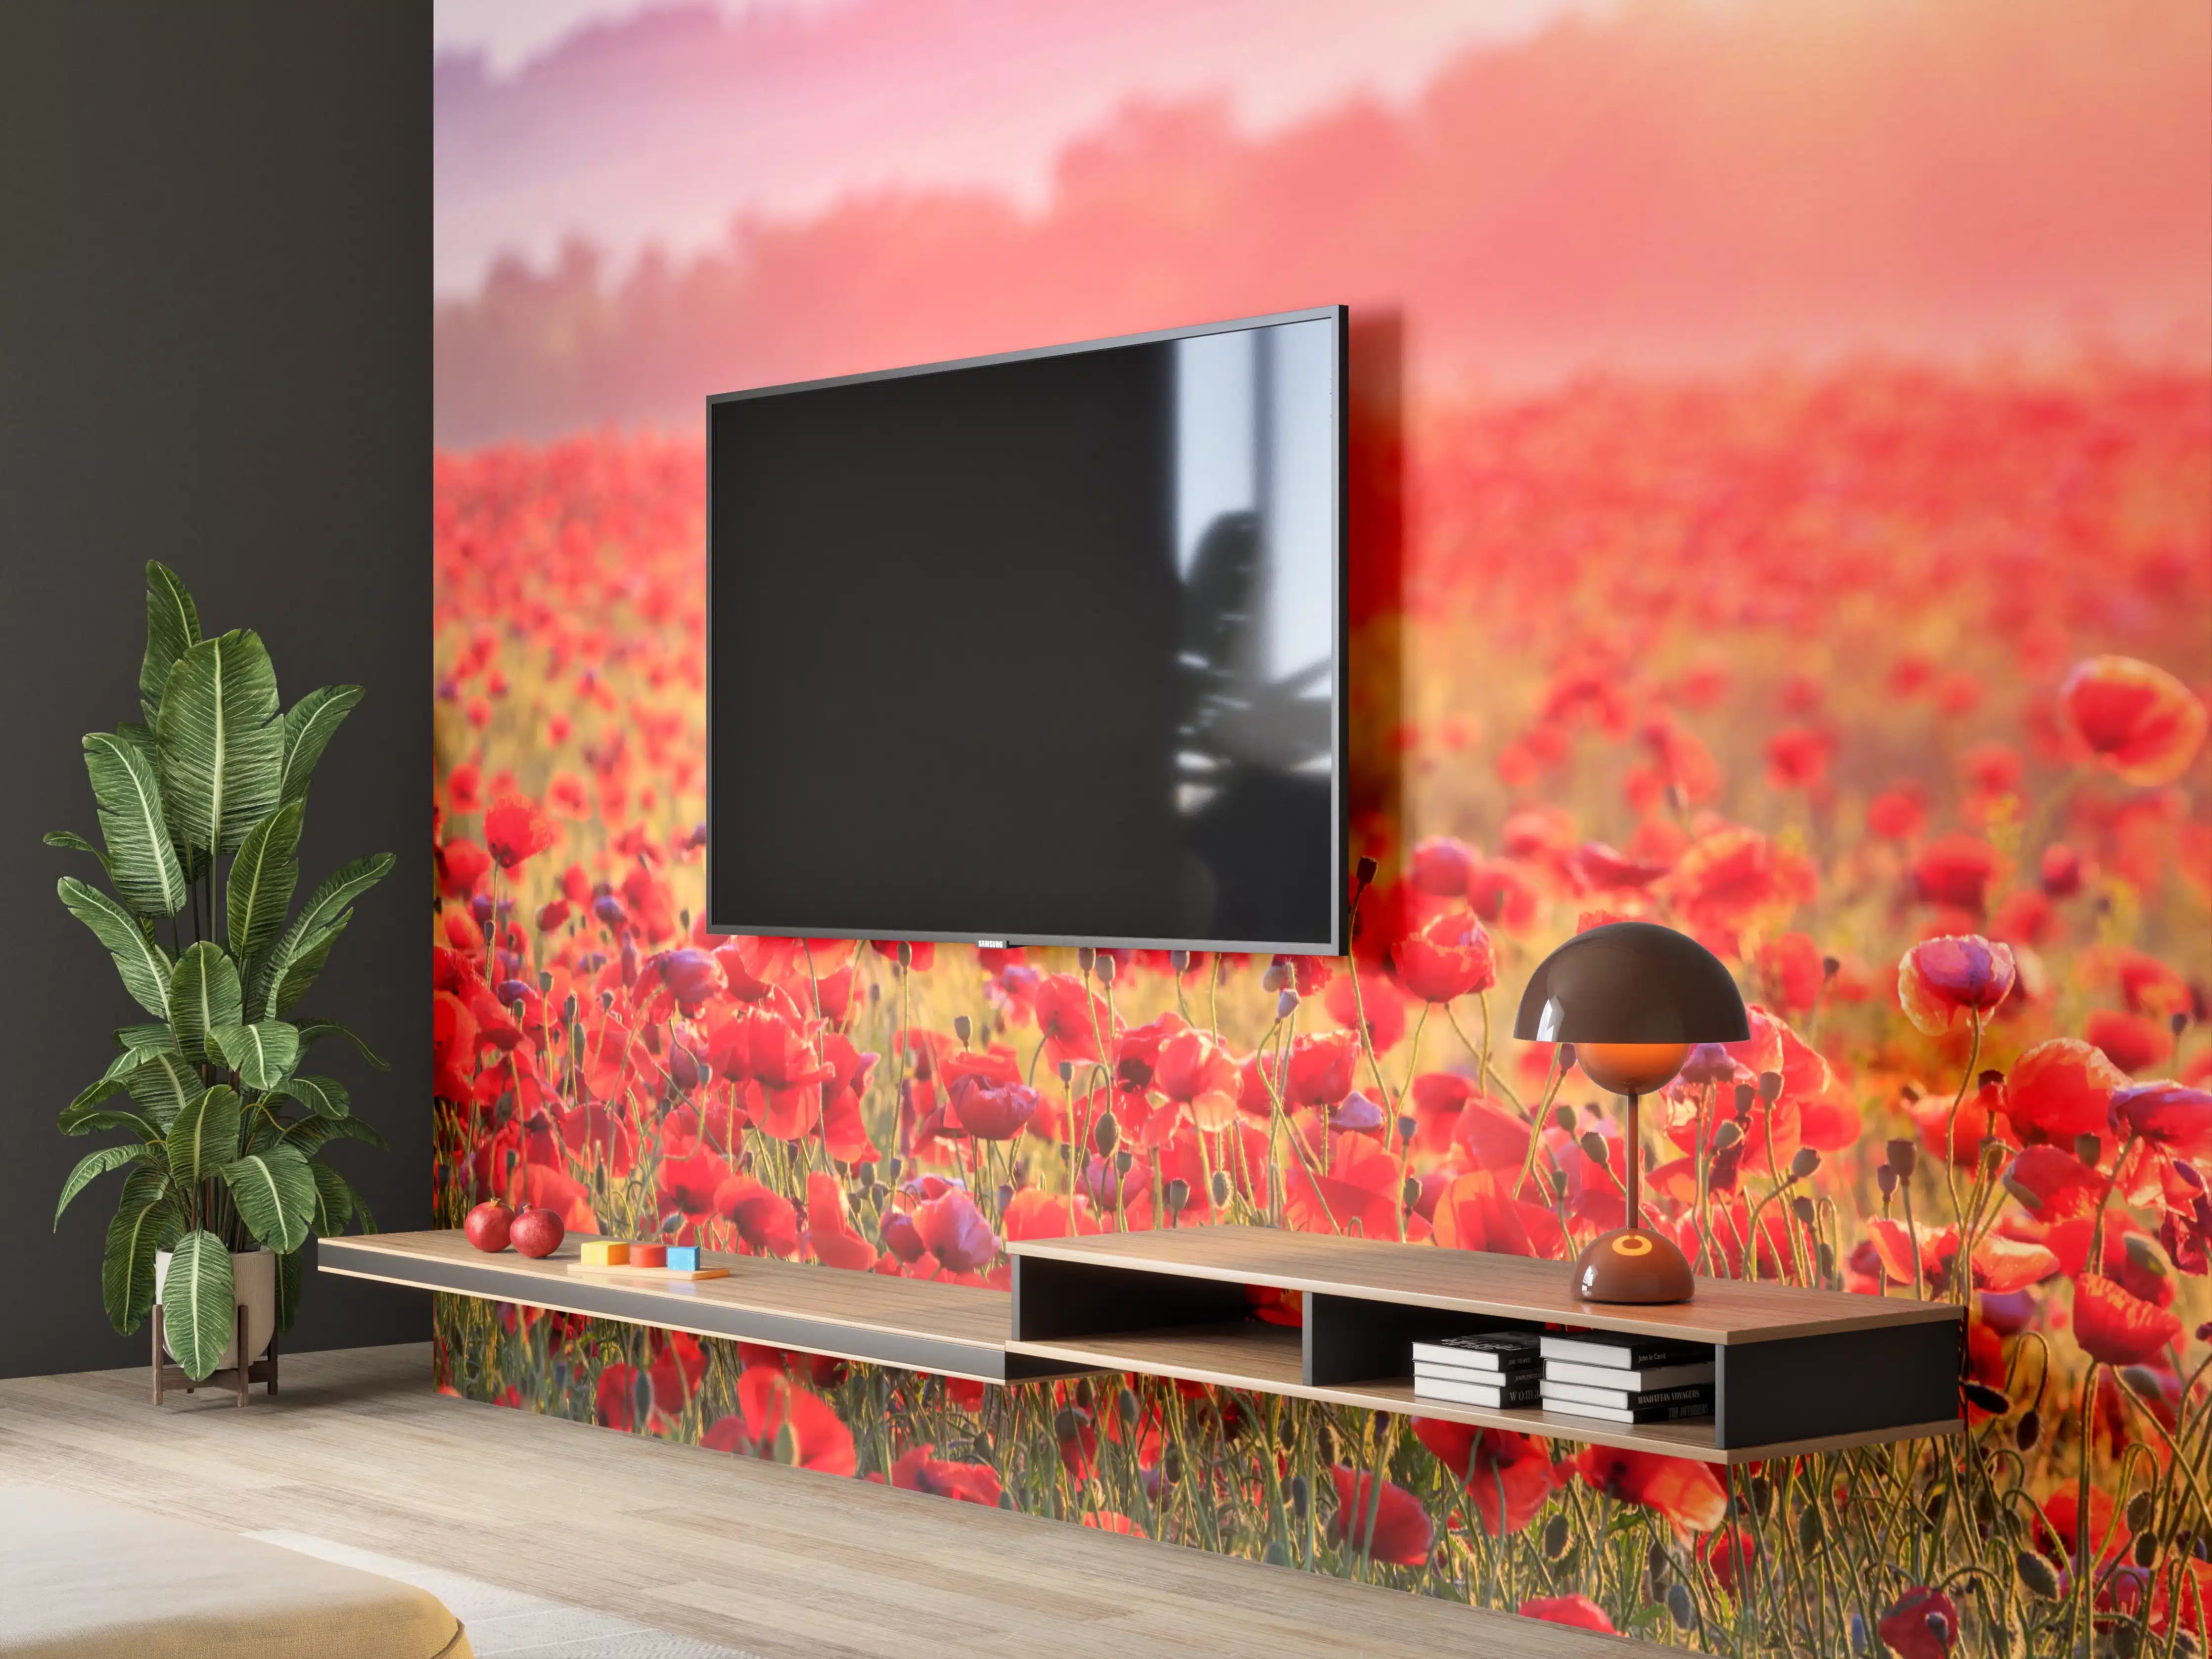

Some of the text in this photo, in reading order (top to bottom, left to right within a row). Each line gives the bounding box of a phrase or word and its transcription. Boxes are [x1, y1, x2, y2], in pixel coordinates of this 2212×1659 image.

[1638, 1355, 1648, 1363] John
[1638, 1389, 1700, 1404] MANHATTAN VOYAGERS
[1668, 1407, 1679, 1419] THE
